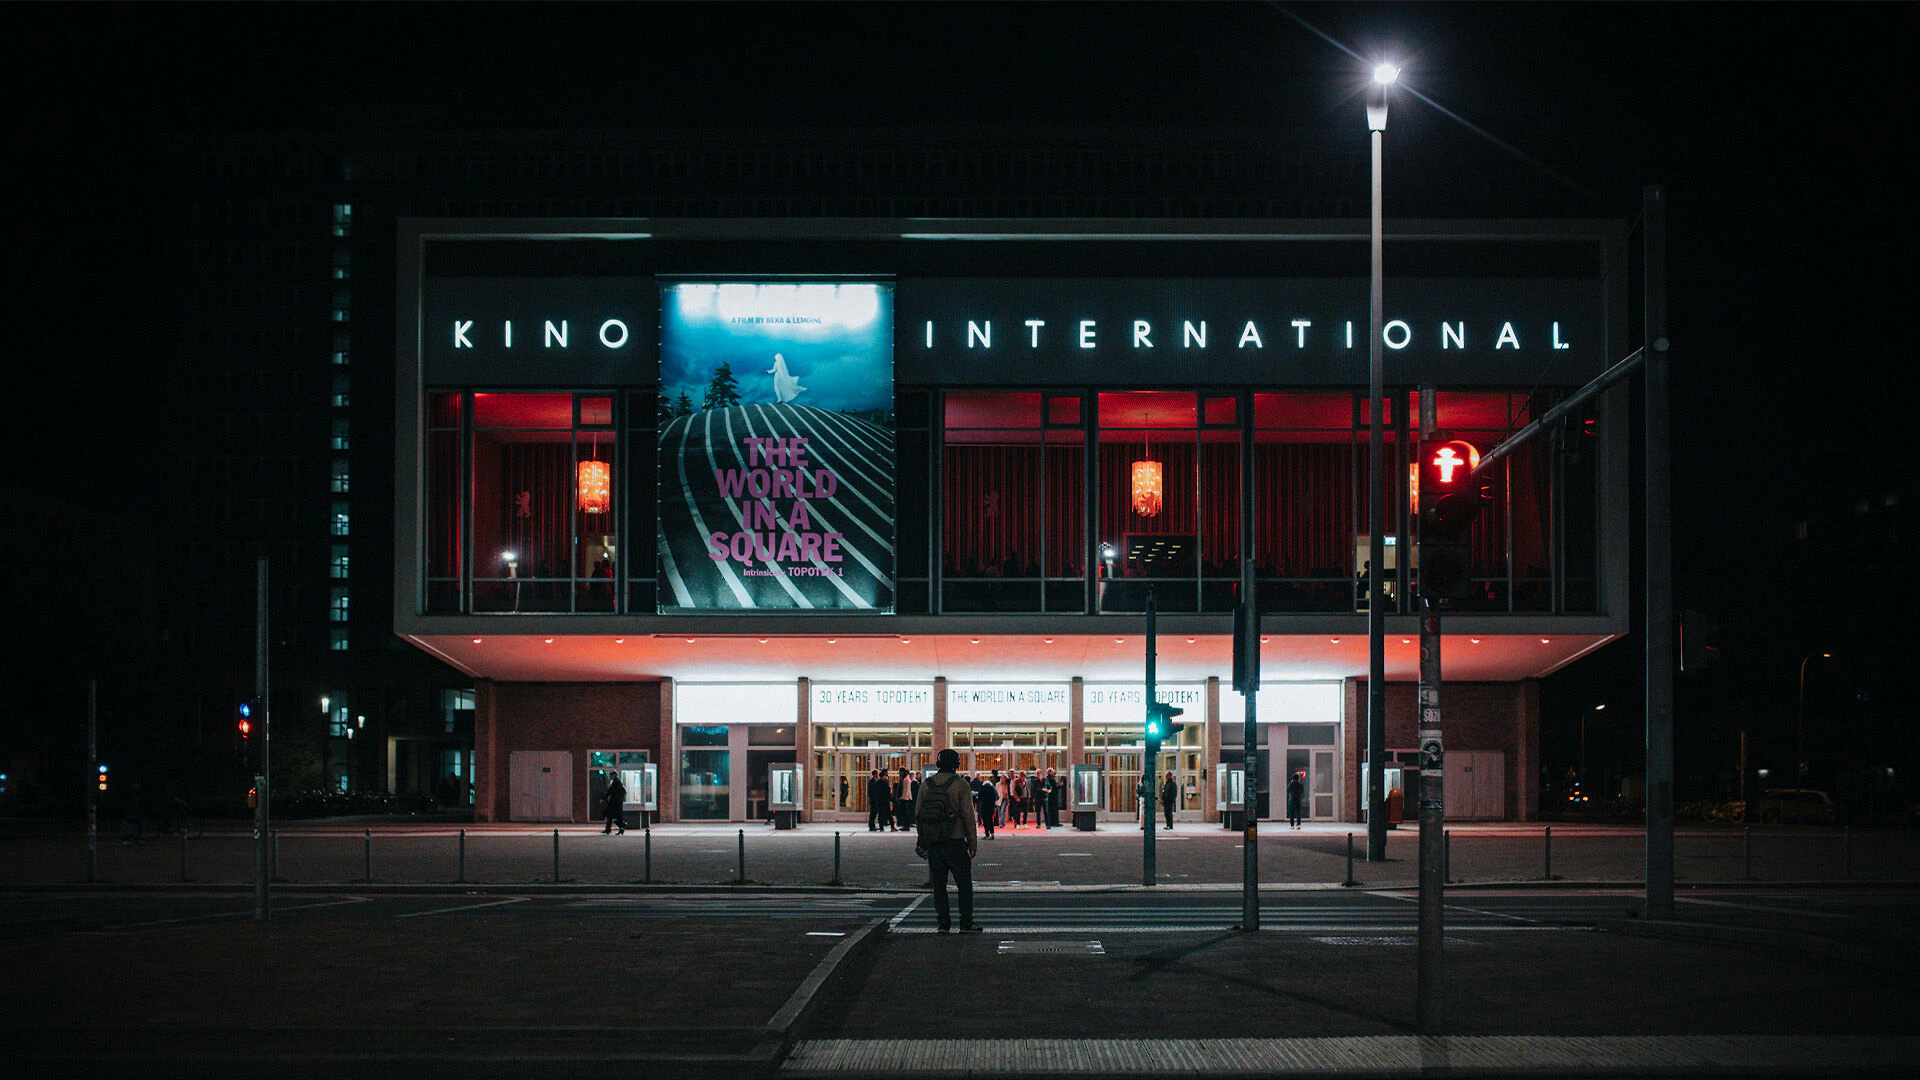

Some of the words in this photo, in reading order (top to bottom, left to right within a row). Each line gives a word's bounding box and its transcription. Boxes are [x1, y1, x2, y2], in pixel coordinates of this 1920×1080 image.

[455, 319, 629, 349] KINO
[926, 319, 1569, 350] INTERNATIONAL
[744, 437, 809, 467] THE
[715, 468, 838, 499] WORLD
[743, 501, 776, 530] IN
[788, 501, 811, 530] A
[708, 531, 843, 567] SQUARE
[788, 567, 834, 577] TOPOTEK
[838, 567, 844, 577] 1
[819, 690, 832, 703] 30
[835, 690, 868, 703] YEARS
[952, 690, 968, 703] THE
[972, 690, 1004, 703] WORLD
[1006, 690, 1016, 703] IN
[1018, 690, 1025, 703] A
[1028, 690, 1065, 703] SQUARE
[1090, 690, 1104, 703] 30
[1109, 690, 1140, 703] YEARS
